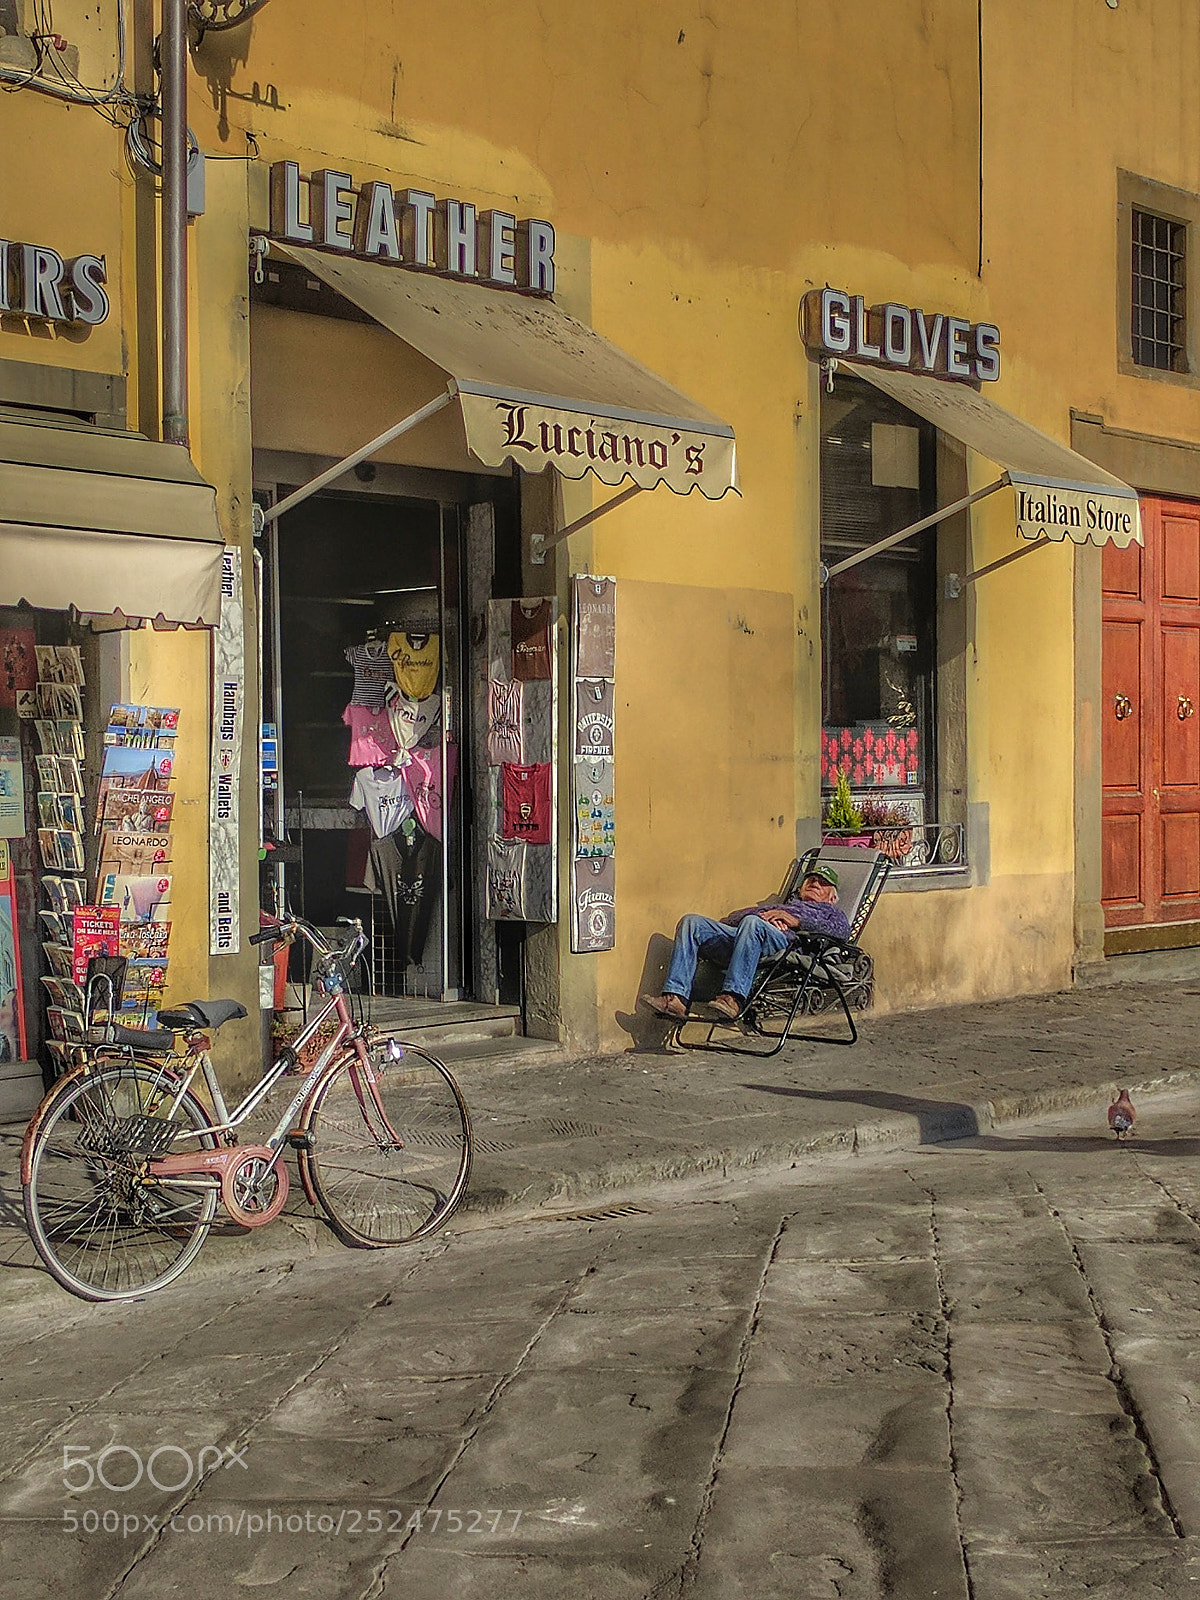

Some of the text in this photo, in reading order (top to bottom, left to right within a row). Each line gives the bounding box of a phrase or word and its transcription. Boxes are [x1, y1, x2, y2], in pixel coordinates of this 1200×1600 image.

[284, 161, 556, 293] LEATHER
[822, 289, 1001, 382] GLOVES
[496, 402, 706, 476] Luciano's
[1018, 491, 1131, 534] Italian Store
[217, 682, 238, 820] Handbags Wallets
[109, 793, 172, 805] MICHELANGELO
[112, 836, 169, 847] LEONARDO
[81, 920, 114, 928] TICKETS
[217, 892, 232, 949] and Belts
[578, 887, 616, 913] Firenze
